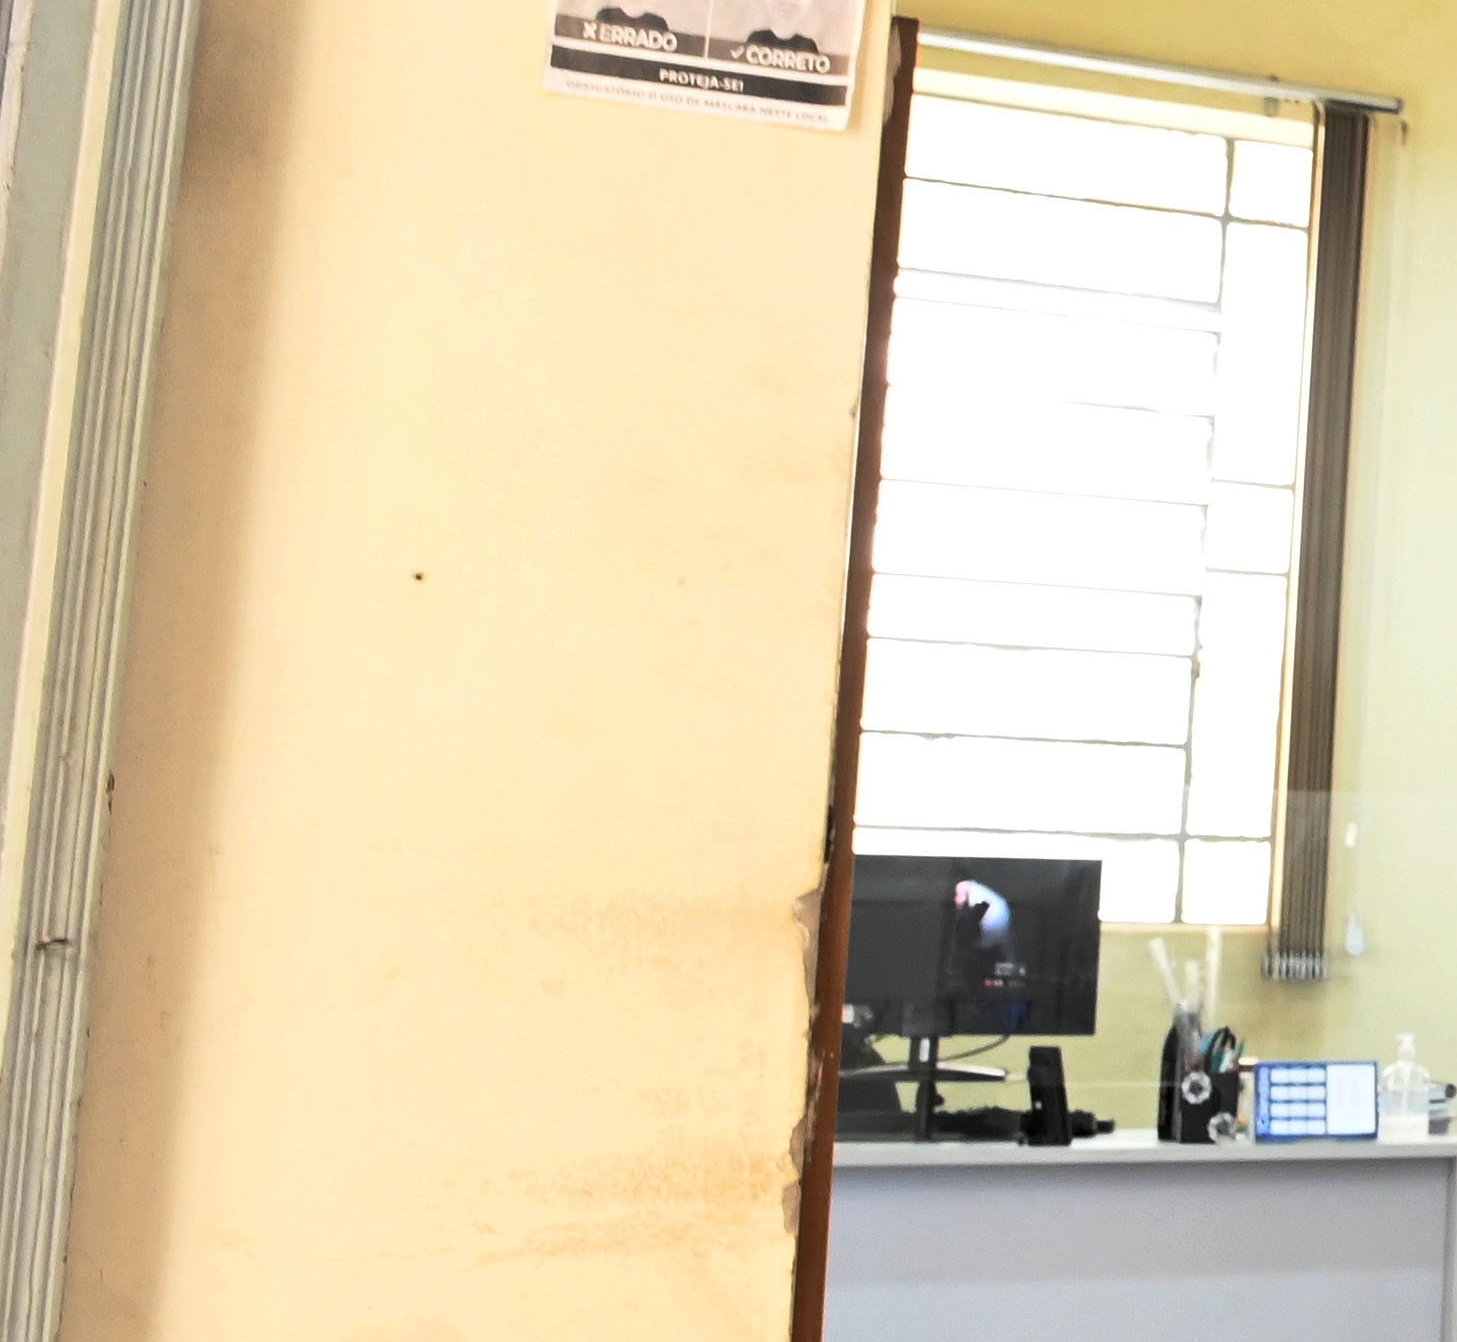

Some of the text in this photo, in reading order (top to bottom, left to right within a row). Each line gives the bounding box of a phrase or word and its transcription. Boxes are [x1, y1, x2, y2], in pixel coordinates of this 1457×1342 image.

[600, 23, 678, 53] ERRADO
[746, 45, 831, 74] CORRETO
[659, 67, 745, 93] PROTEJA-SE!
